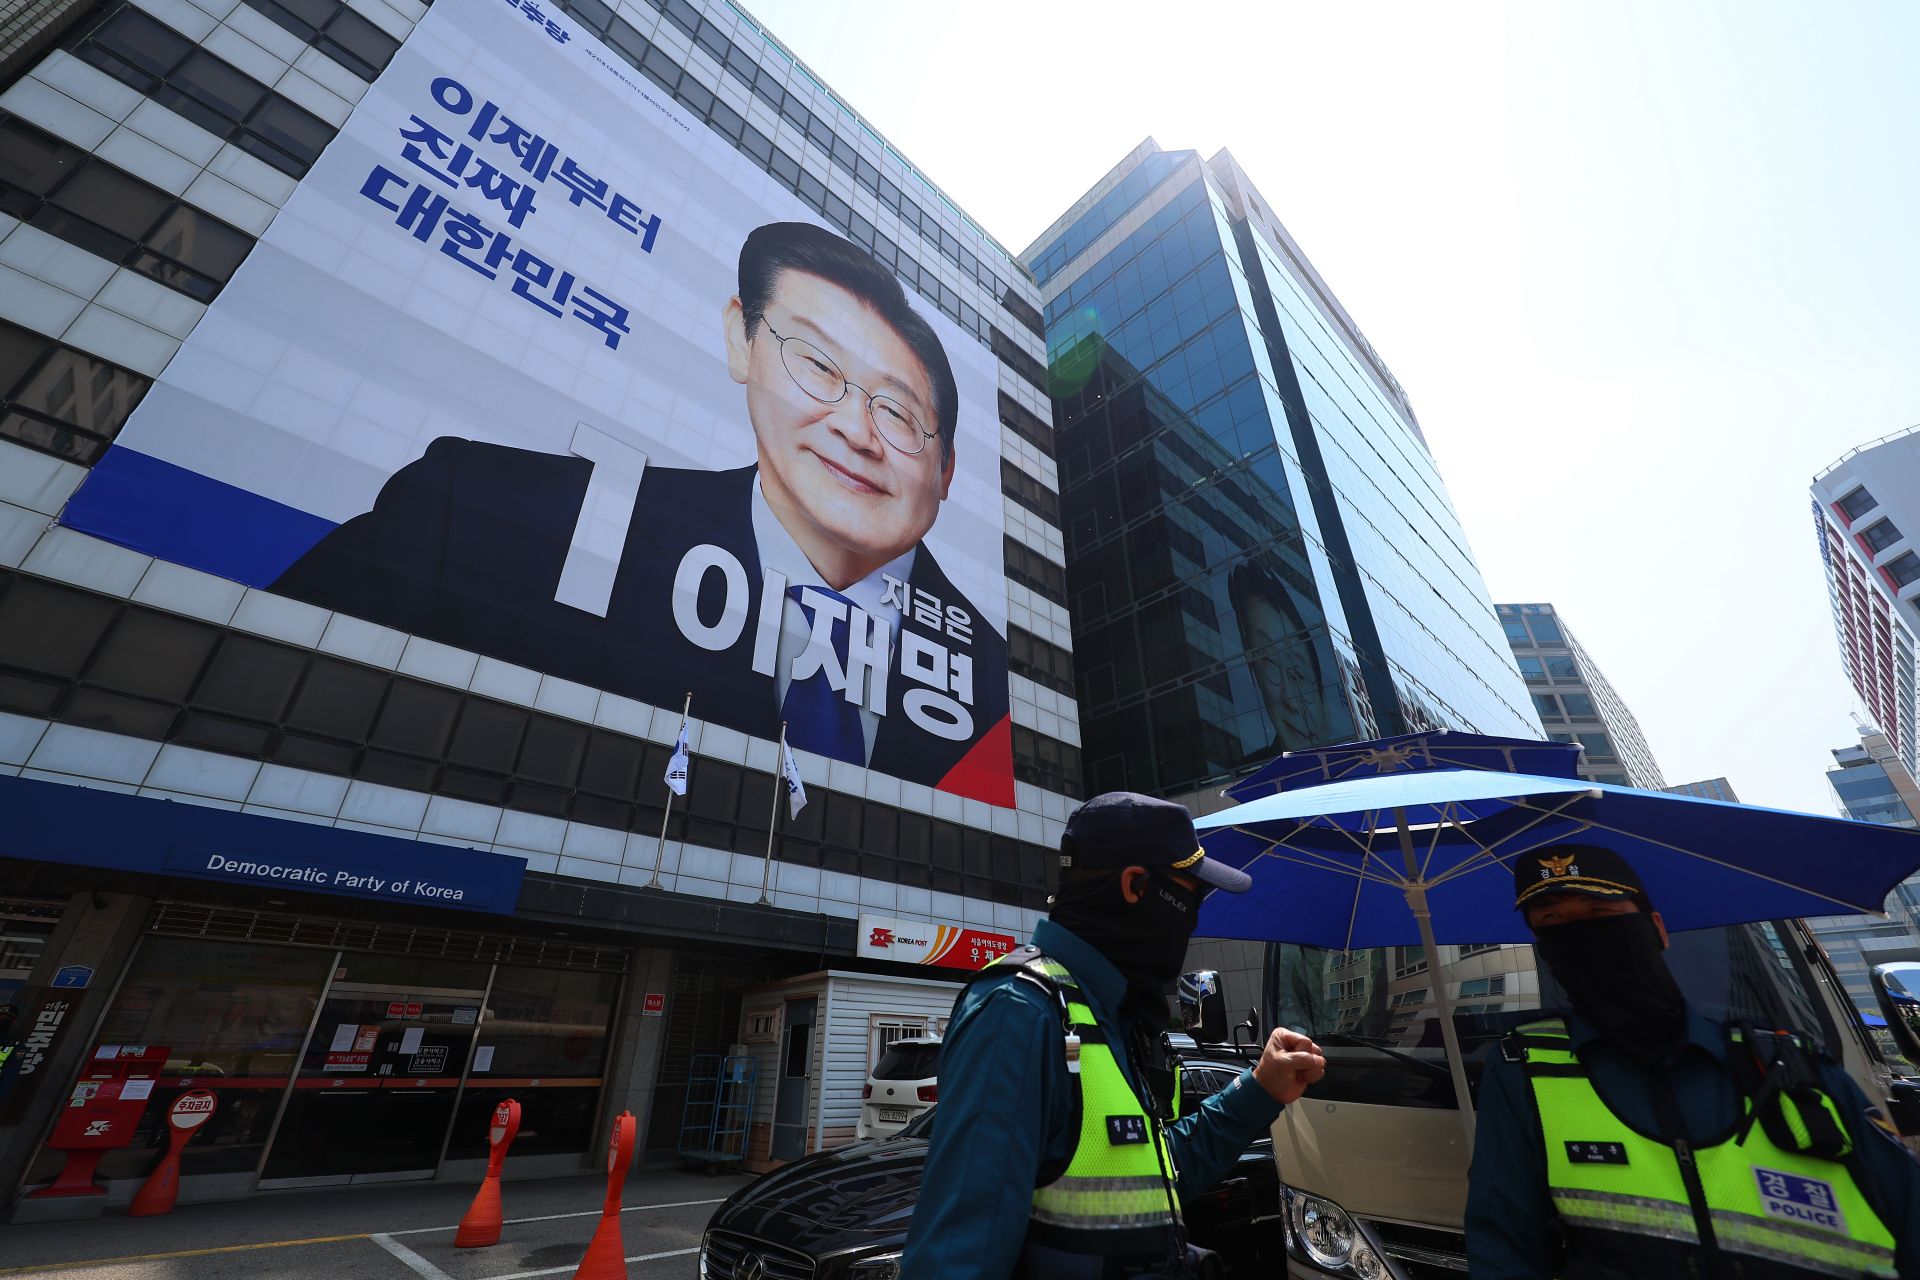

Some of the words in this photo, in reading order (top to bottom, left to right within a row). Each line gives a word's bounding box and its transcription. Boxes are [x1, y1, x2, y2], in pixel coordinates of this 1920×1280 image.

[505, 0, 571, 44] 주당
[399, 114, 537, 230] 진짜
[430, 76, 662, 254] 이제부터
[358, 164, 632, 351] 대한민국
[879, 572, 973, 645] 지금은
[672, 544, 975, 742] 이재명
[206, 853, 328, 884] Democratic
[334, 870, 386, 892] Party
[391, 880, 410, 893] of
[414, 881, 464, 901] Korea
[897, 936, 915, 945] KOREA
[914, 939, 928, 947] POST
[67, 976, 77, 985] 7
[18, 1010, 65, 1075] 민주당
[179, 1100, 212, 1110] 주차금지
[1760, 1172, 1830, 1209] 경찰
[1770, 1201, 1839, 1227] POLICE
